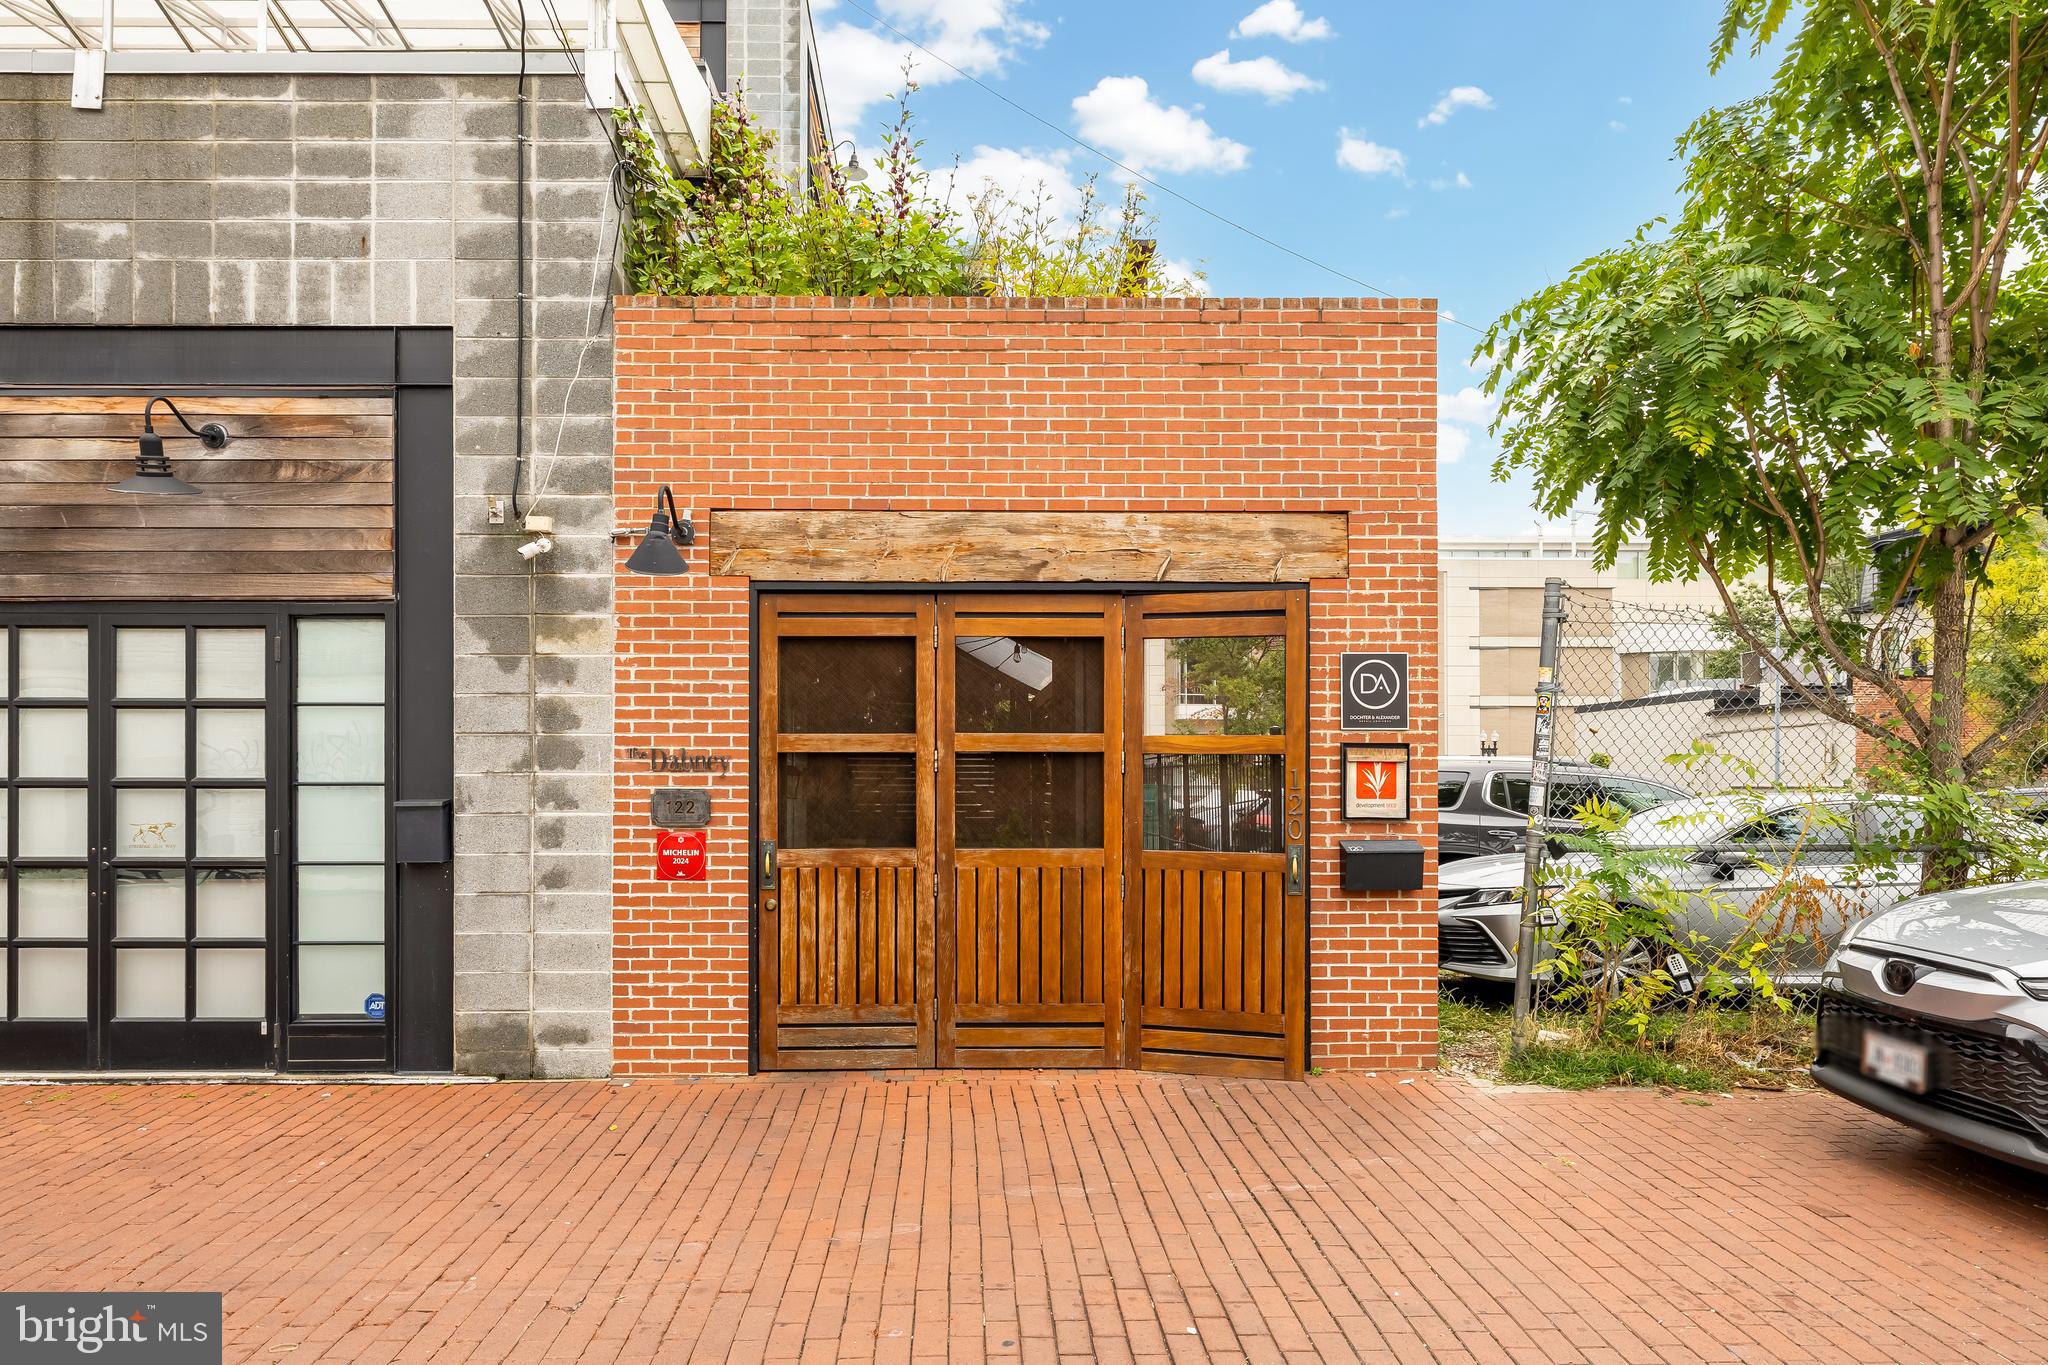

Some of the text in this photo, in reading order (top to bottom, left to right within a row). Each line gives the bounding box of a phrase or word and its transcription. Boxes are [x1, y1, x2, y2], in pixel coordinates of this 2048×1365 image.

[627, 748, 731, 778] The Dabney
[666, 800, 695, 814] 122
[1288, 767, 1303, 840] 120
[369, 1001, 385, 1010] ADT
